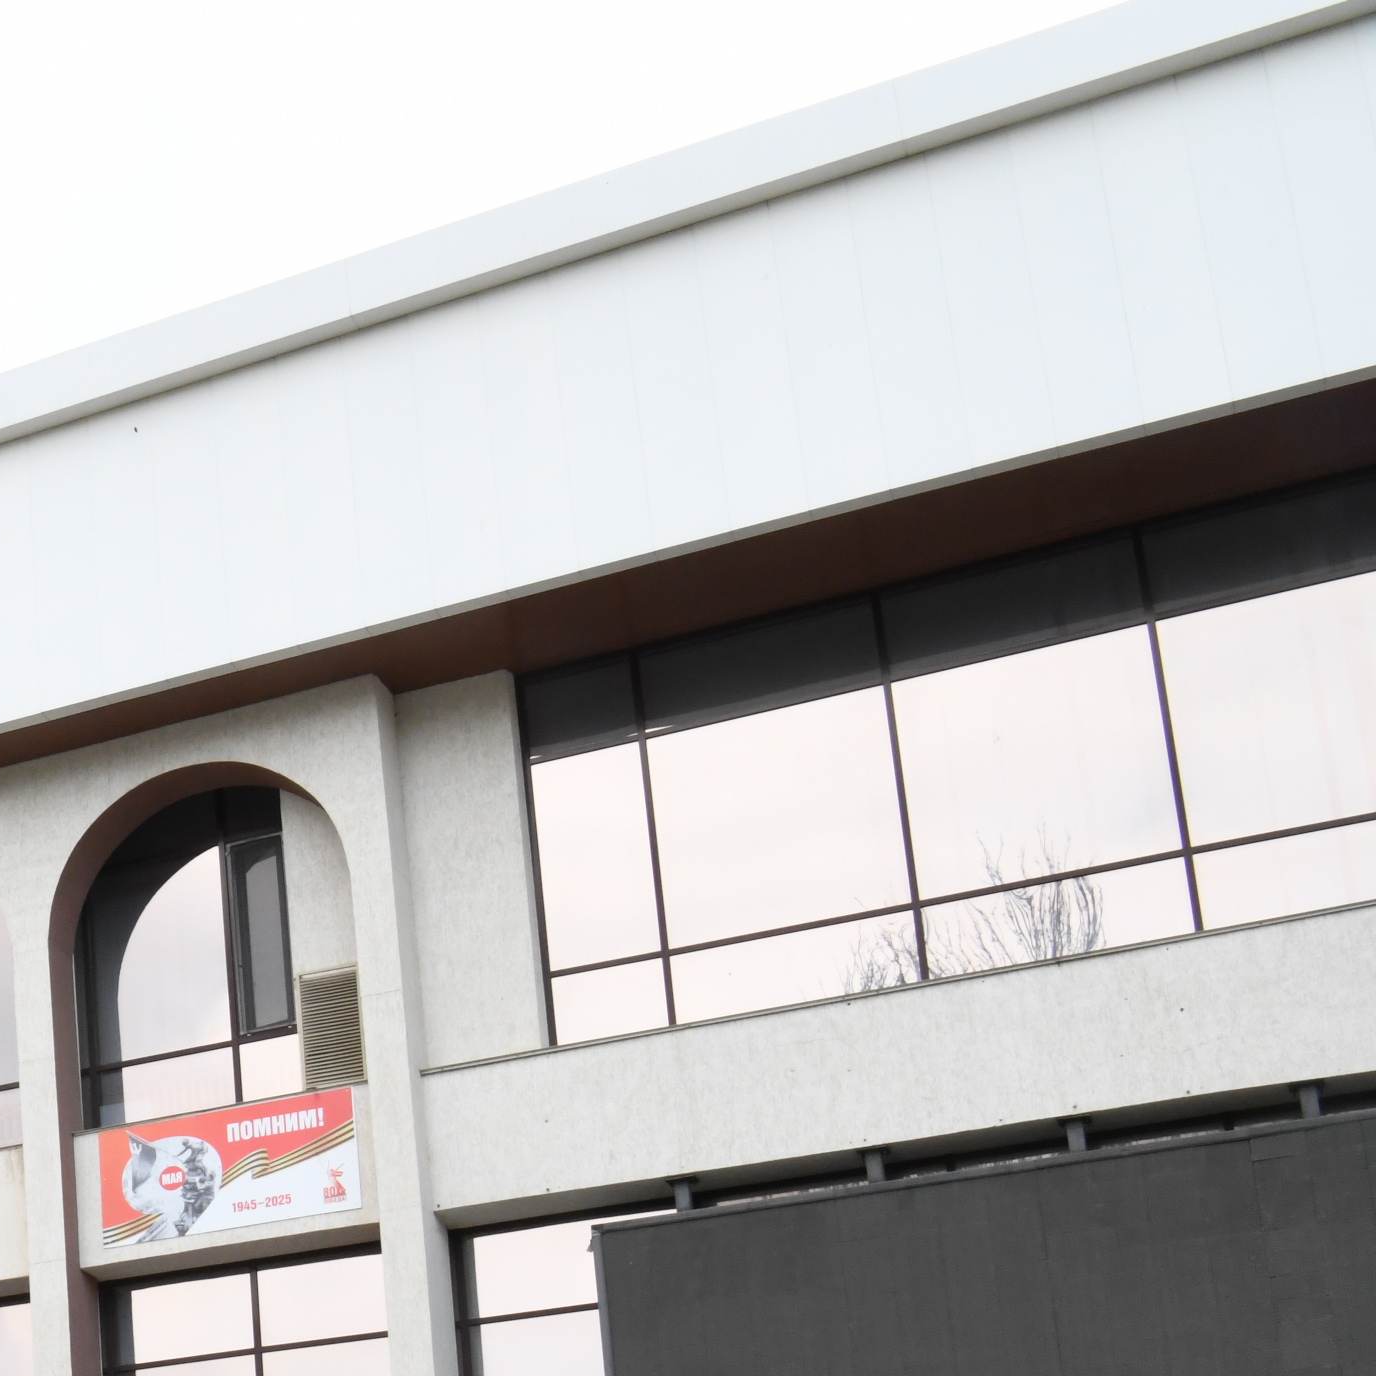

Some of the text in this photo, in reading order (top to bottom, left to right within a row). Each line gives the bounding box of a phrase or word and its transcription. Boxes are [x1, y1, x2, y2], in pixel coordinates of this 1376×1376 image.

[226, 1107, 324, 1142] ПОМНИМ!
[161, 1171, 183, 1186] МАЯ
[232, 1193, 292, 1213] 1945-2025
